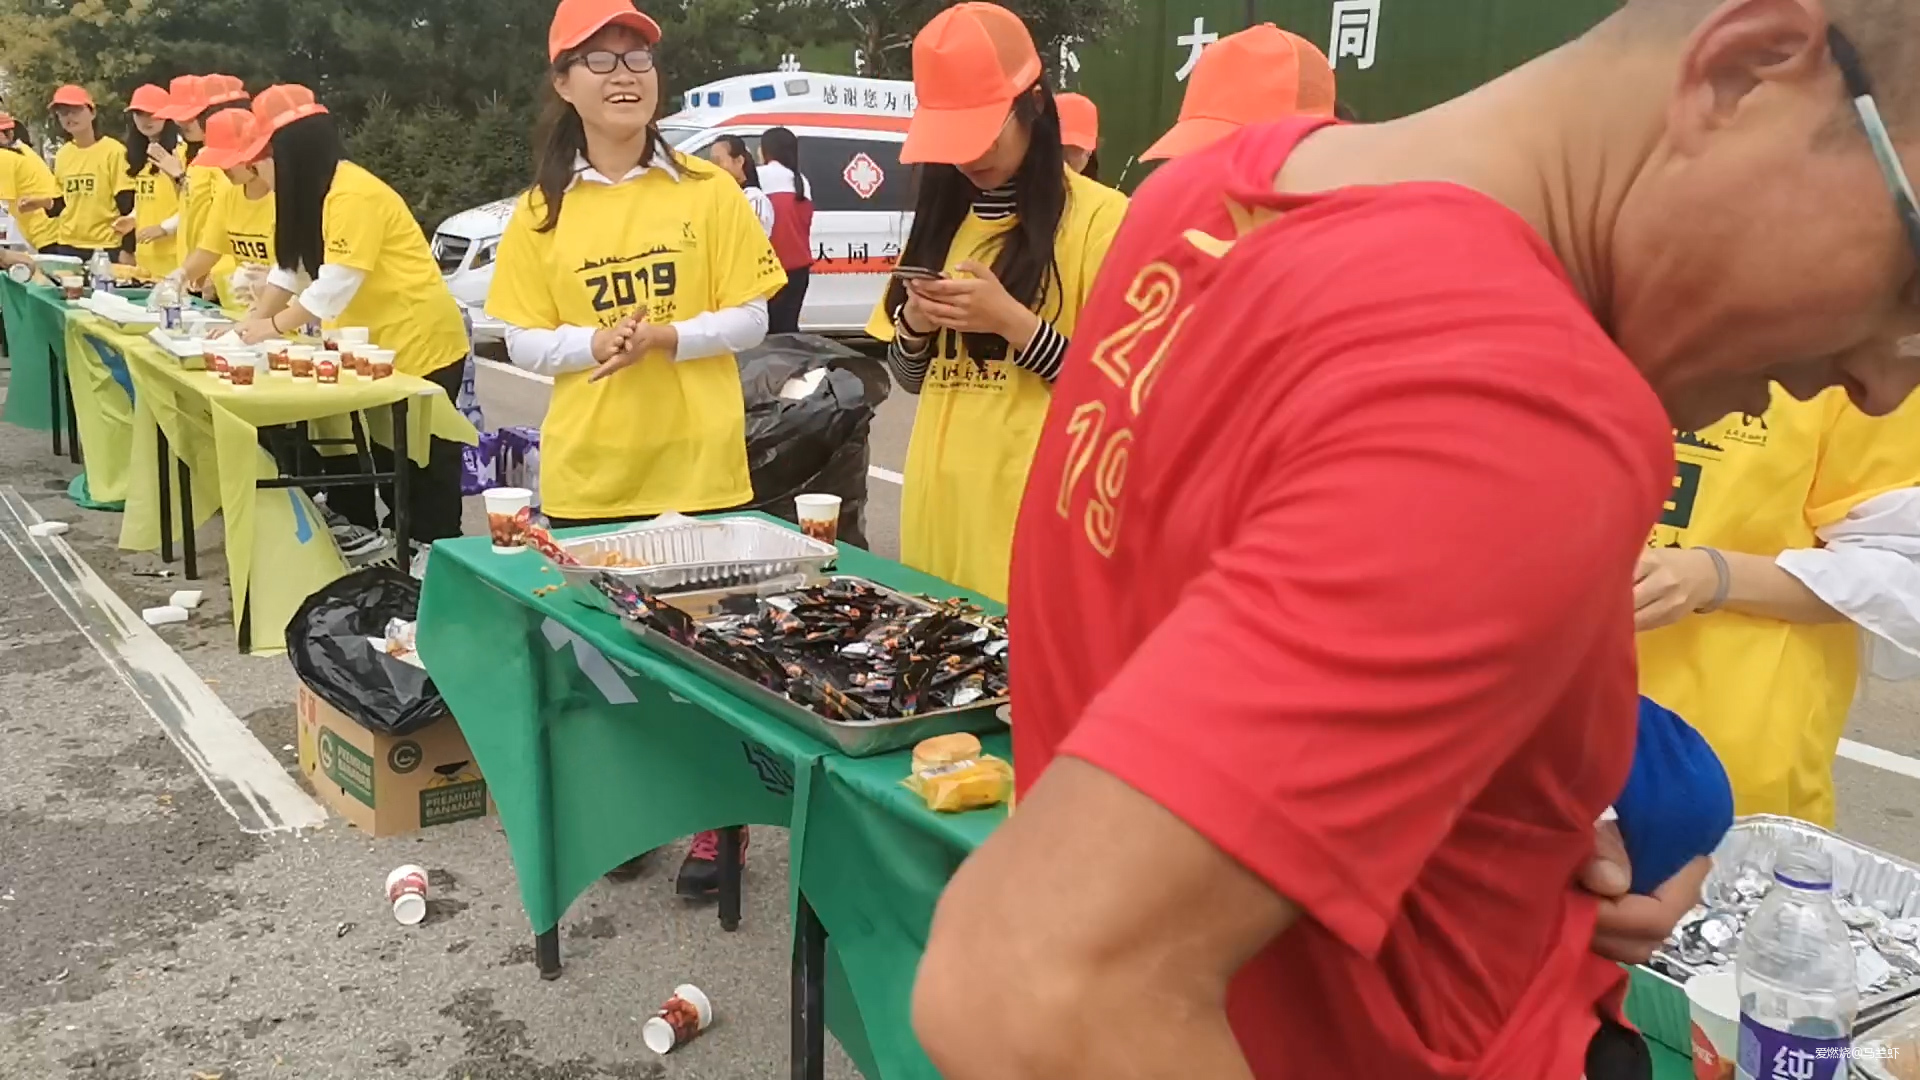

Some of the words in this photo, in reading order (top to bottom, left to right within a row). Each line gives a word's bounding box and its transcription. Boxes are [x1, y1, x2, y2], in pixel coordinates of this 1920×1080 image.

[230, 239, 268, 259] 2019
[585, 261, 676, 312] 2019
[425, 790, 482, 807] PREMIUM
